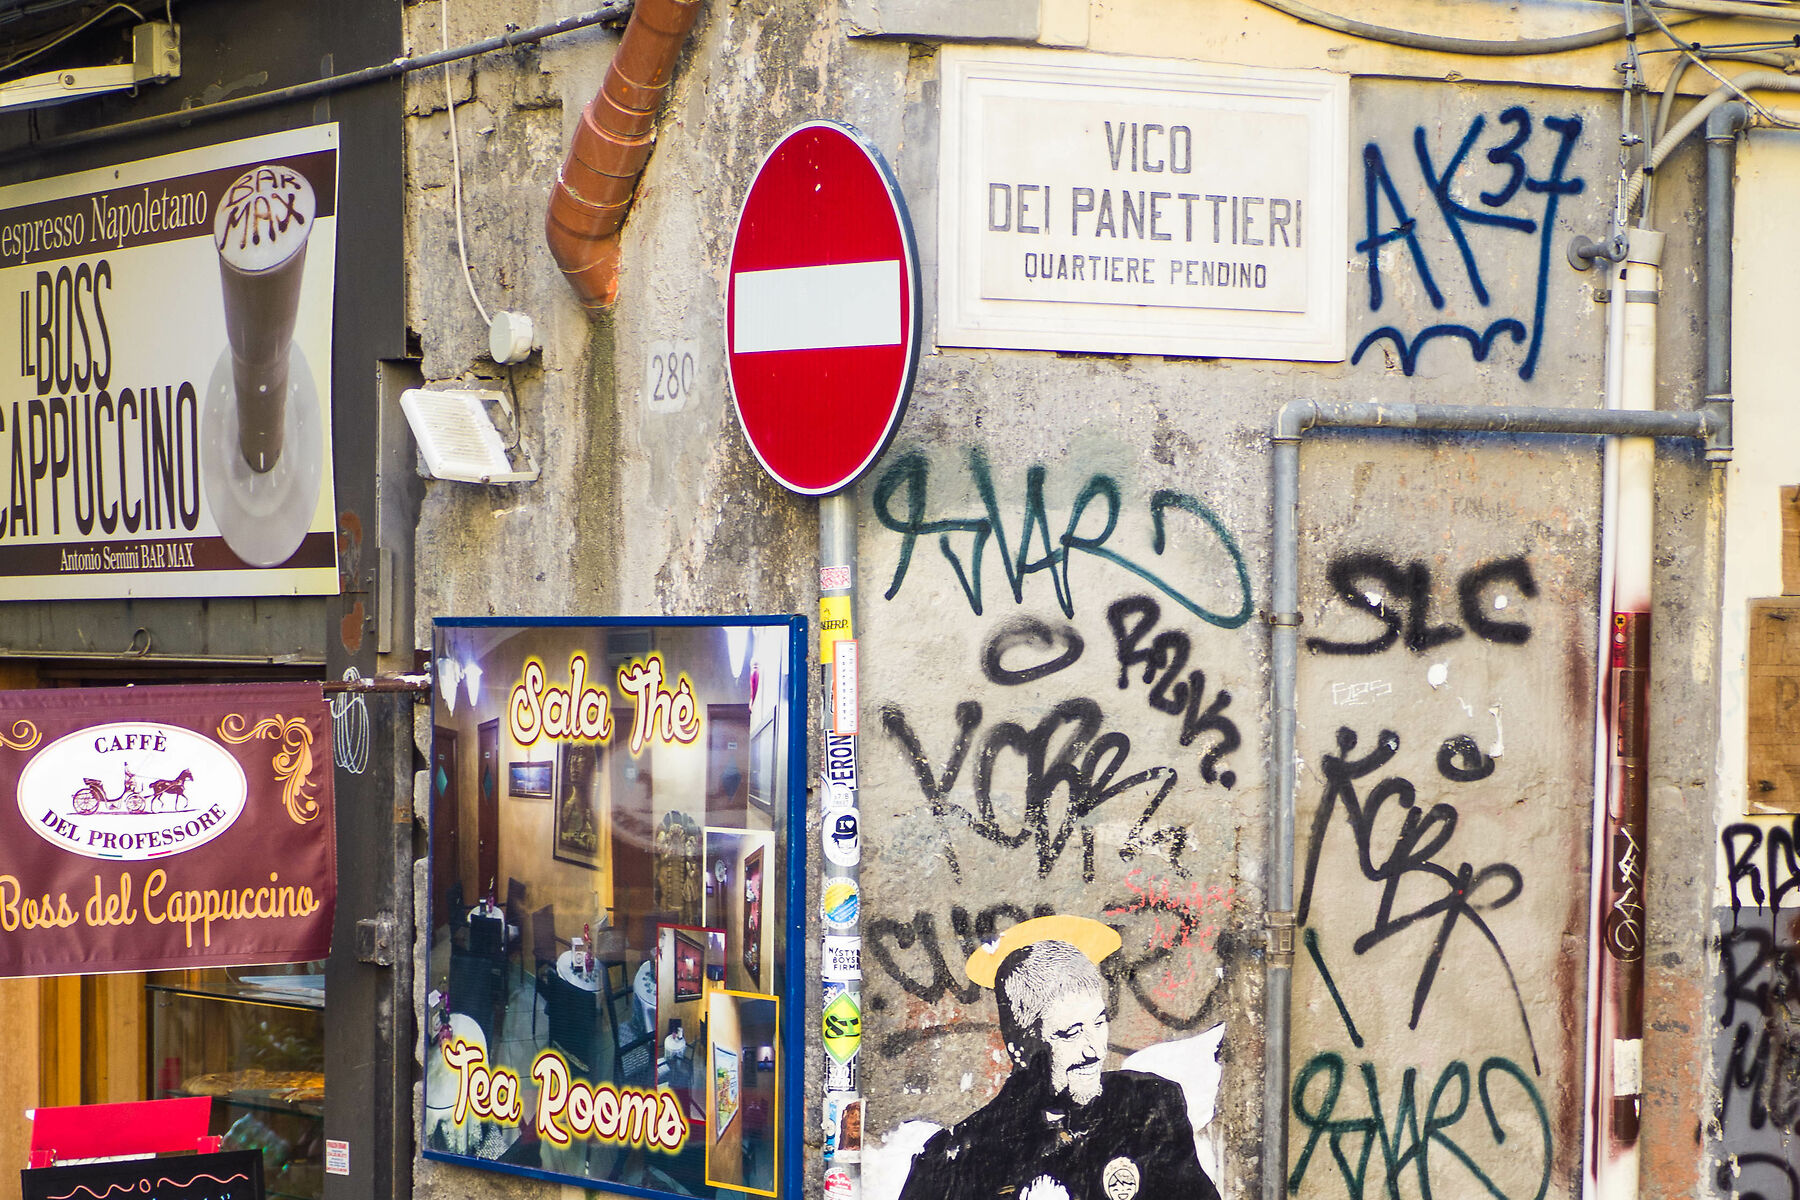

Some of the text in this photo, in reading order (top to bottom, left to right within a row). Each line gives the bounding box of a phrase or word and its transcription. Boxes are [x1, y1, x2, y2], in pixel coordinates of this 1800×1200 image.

[1104, 121, 1192, 174] VICO
[228, 168, 301, 208] BAR
[989, 183, 1302, 248] DEI PANETTIERI
[2, 188, 208, 262] espresso Napoletano
[219, 193, 305, 250] MAX
[1025, 252, 1268, 289] QUARTIERE PENDINO
[20, 259, 112, 396] IL BOSS
[652, 352, 694, 401] 280
[60, 542, 195, 571] Antonio Semini BAR MAX
[510, 655, 611, 746] Sala
[94, 731, 167, 753] CAFFÈ
[823, 728, 854, 790] ERON
[40, 803, 226, 850] DEL PROFESSORE
[0, 869, 320, 948] Boss del Cappuccino
[445, 1042, 688, 1151] Tea Rooms
